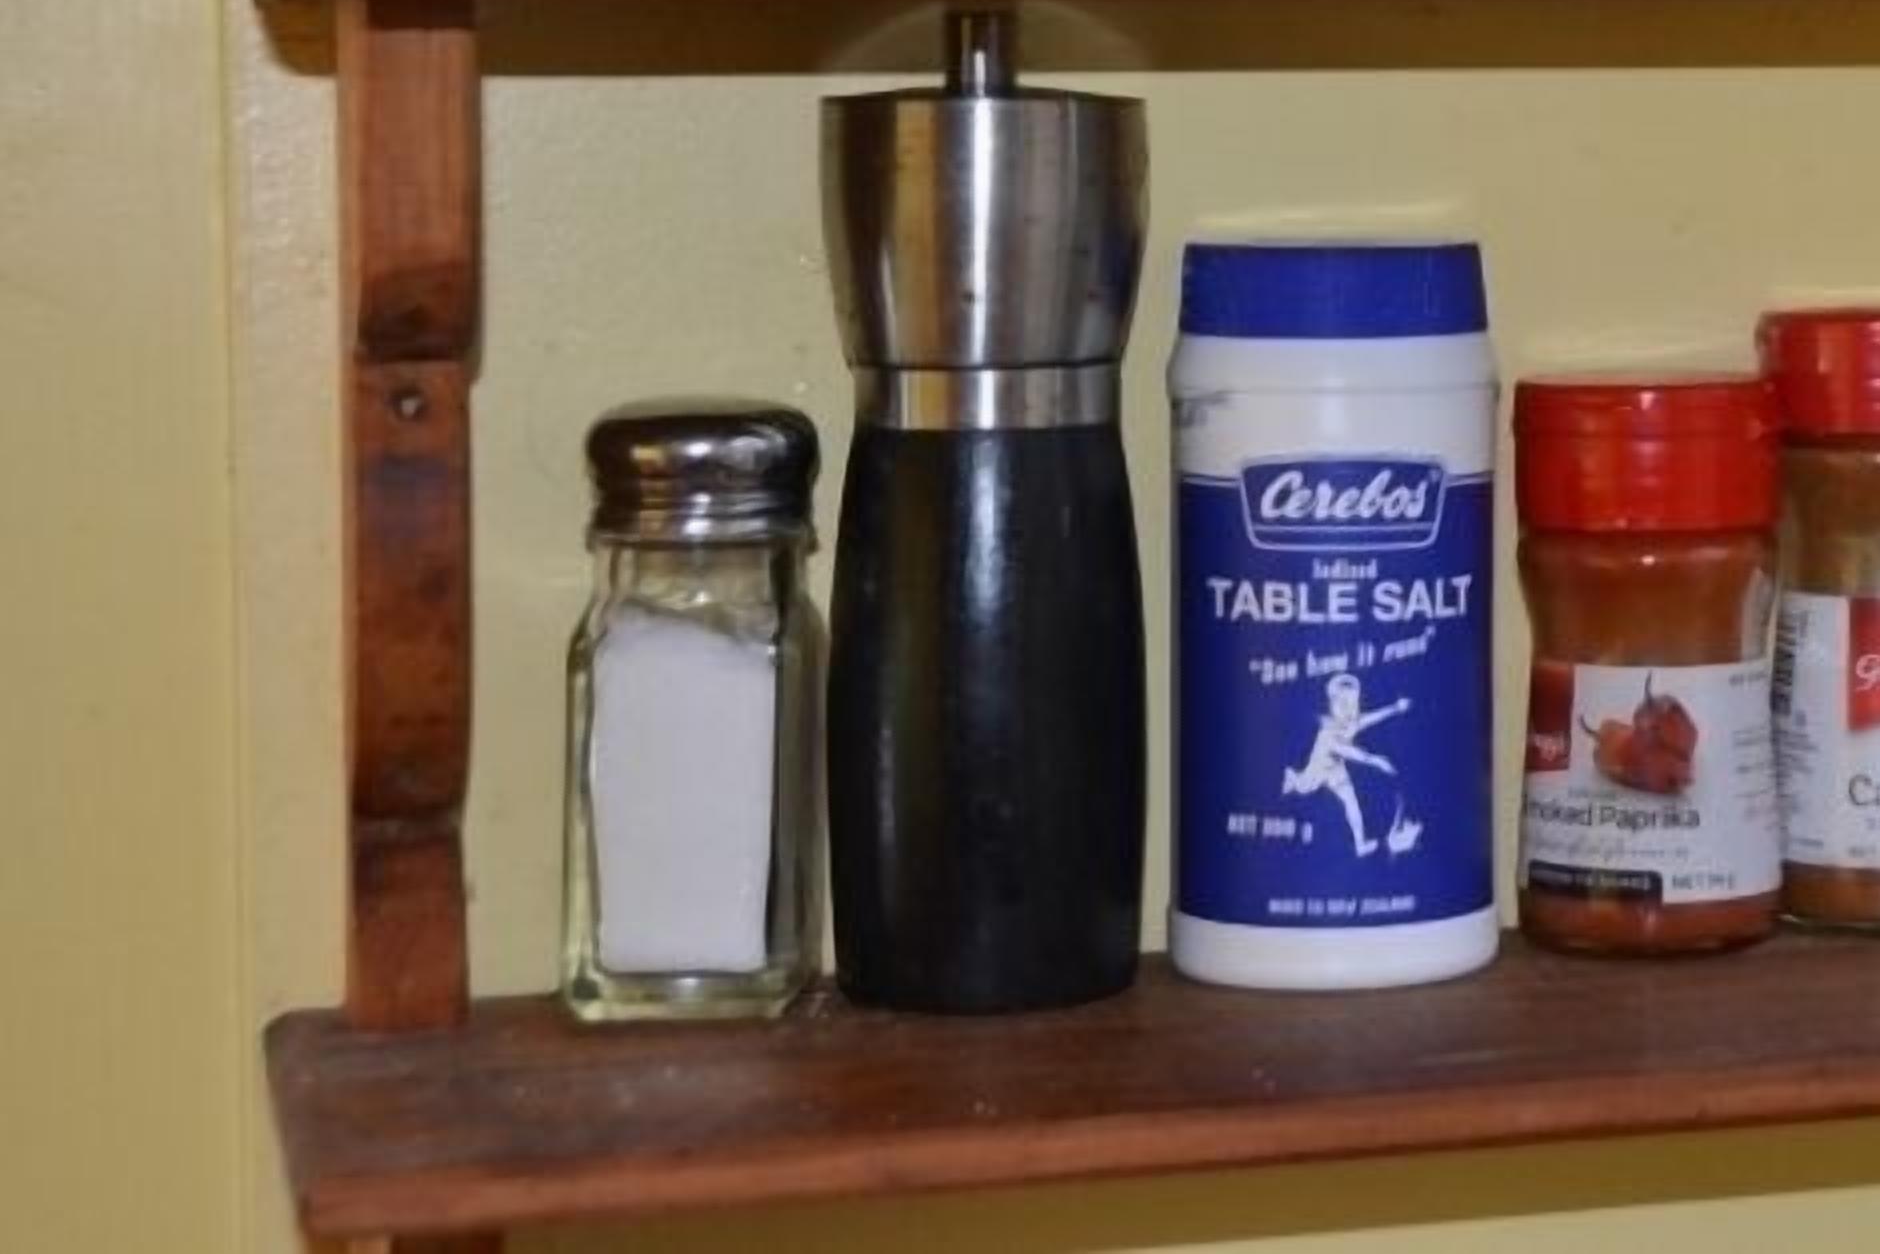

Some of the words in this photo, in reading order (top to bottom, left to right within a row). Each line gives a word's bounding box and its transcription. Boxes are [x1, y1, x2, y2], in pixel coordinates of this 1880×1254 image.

[1260, 469, 1427, 520] Cerebos
[1206, 578, 1360, 623] TABLE
[1372, 574, 1473, 623] SALT
